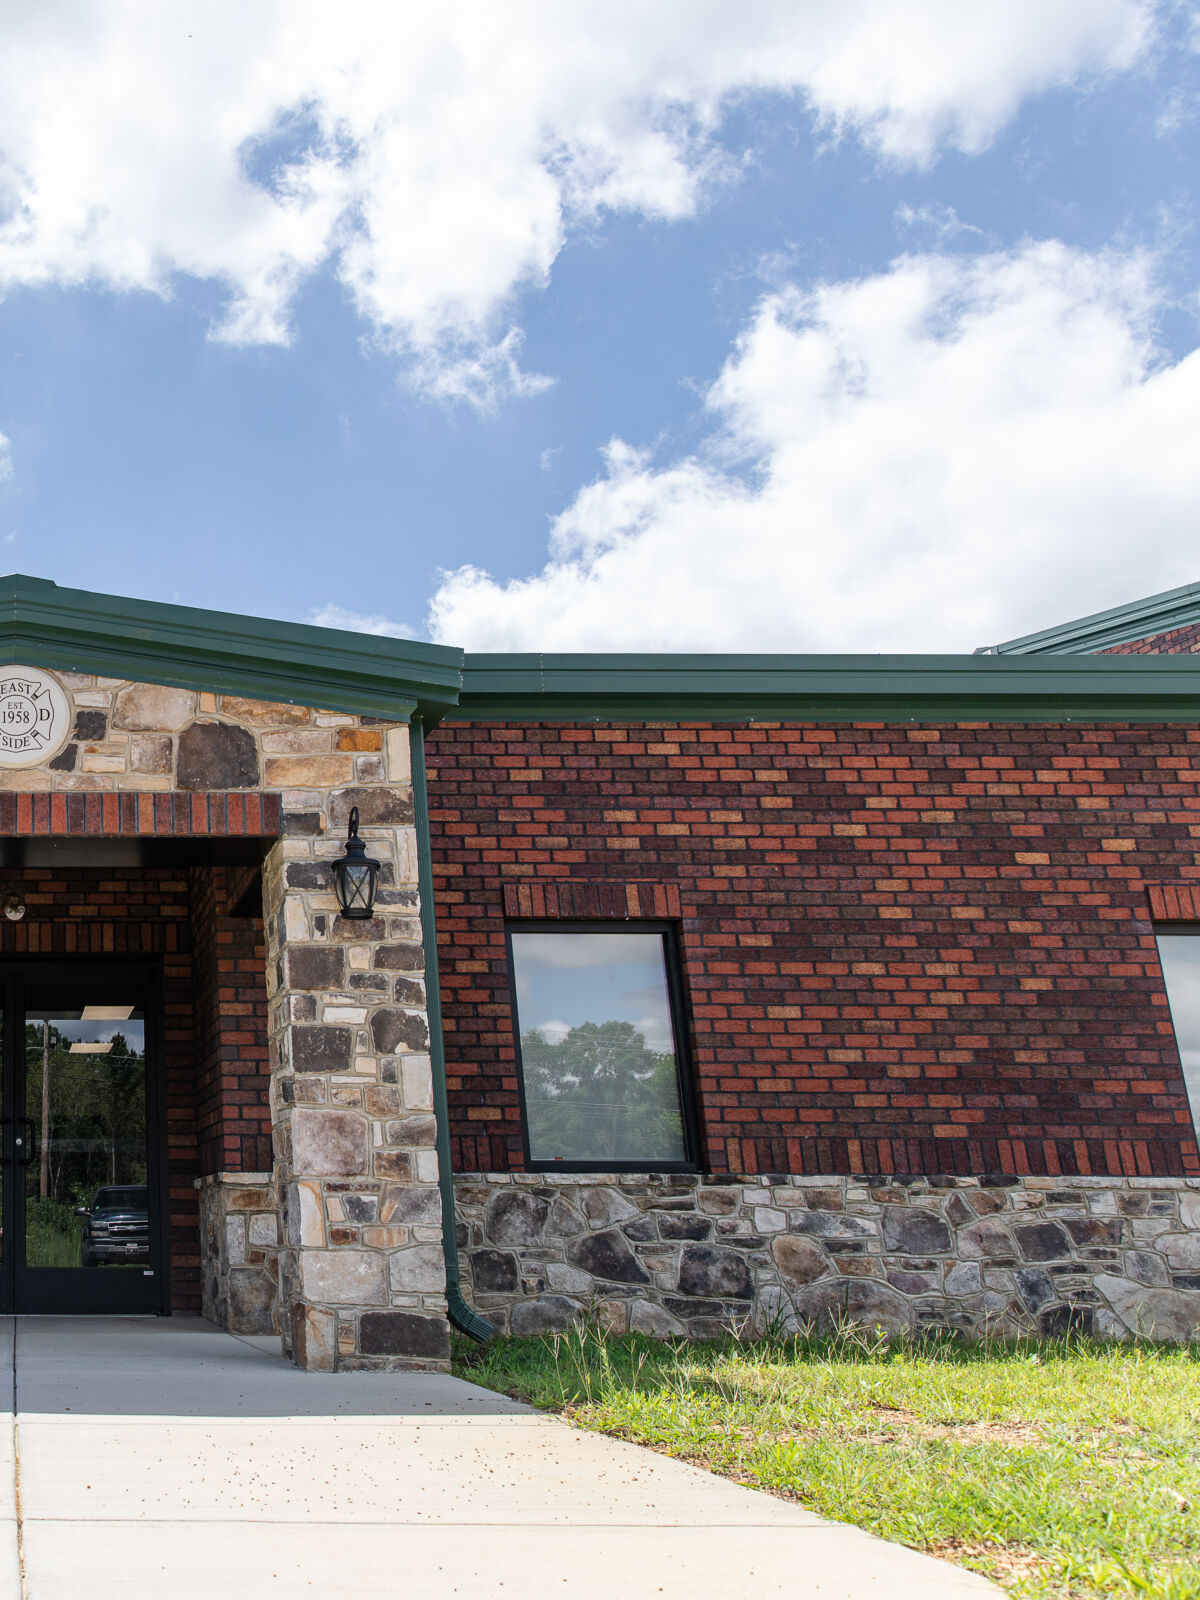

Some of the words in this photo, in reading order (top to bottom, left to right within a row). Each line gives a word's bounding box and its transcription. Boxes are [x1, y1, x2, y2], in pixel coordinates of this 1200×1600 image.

[0, 682, 32, 695] EAST
[2, 711, 30, 724] 1958
[39, 708, 50, 721] D
[2, 736, 30, 748] SIDE
